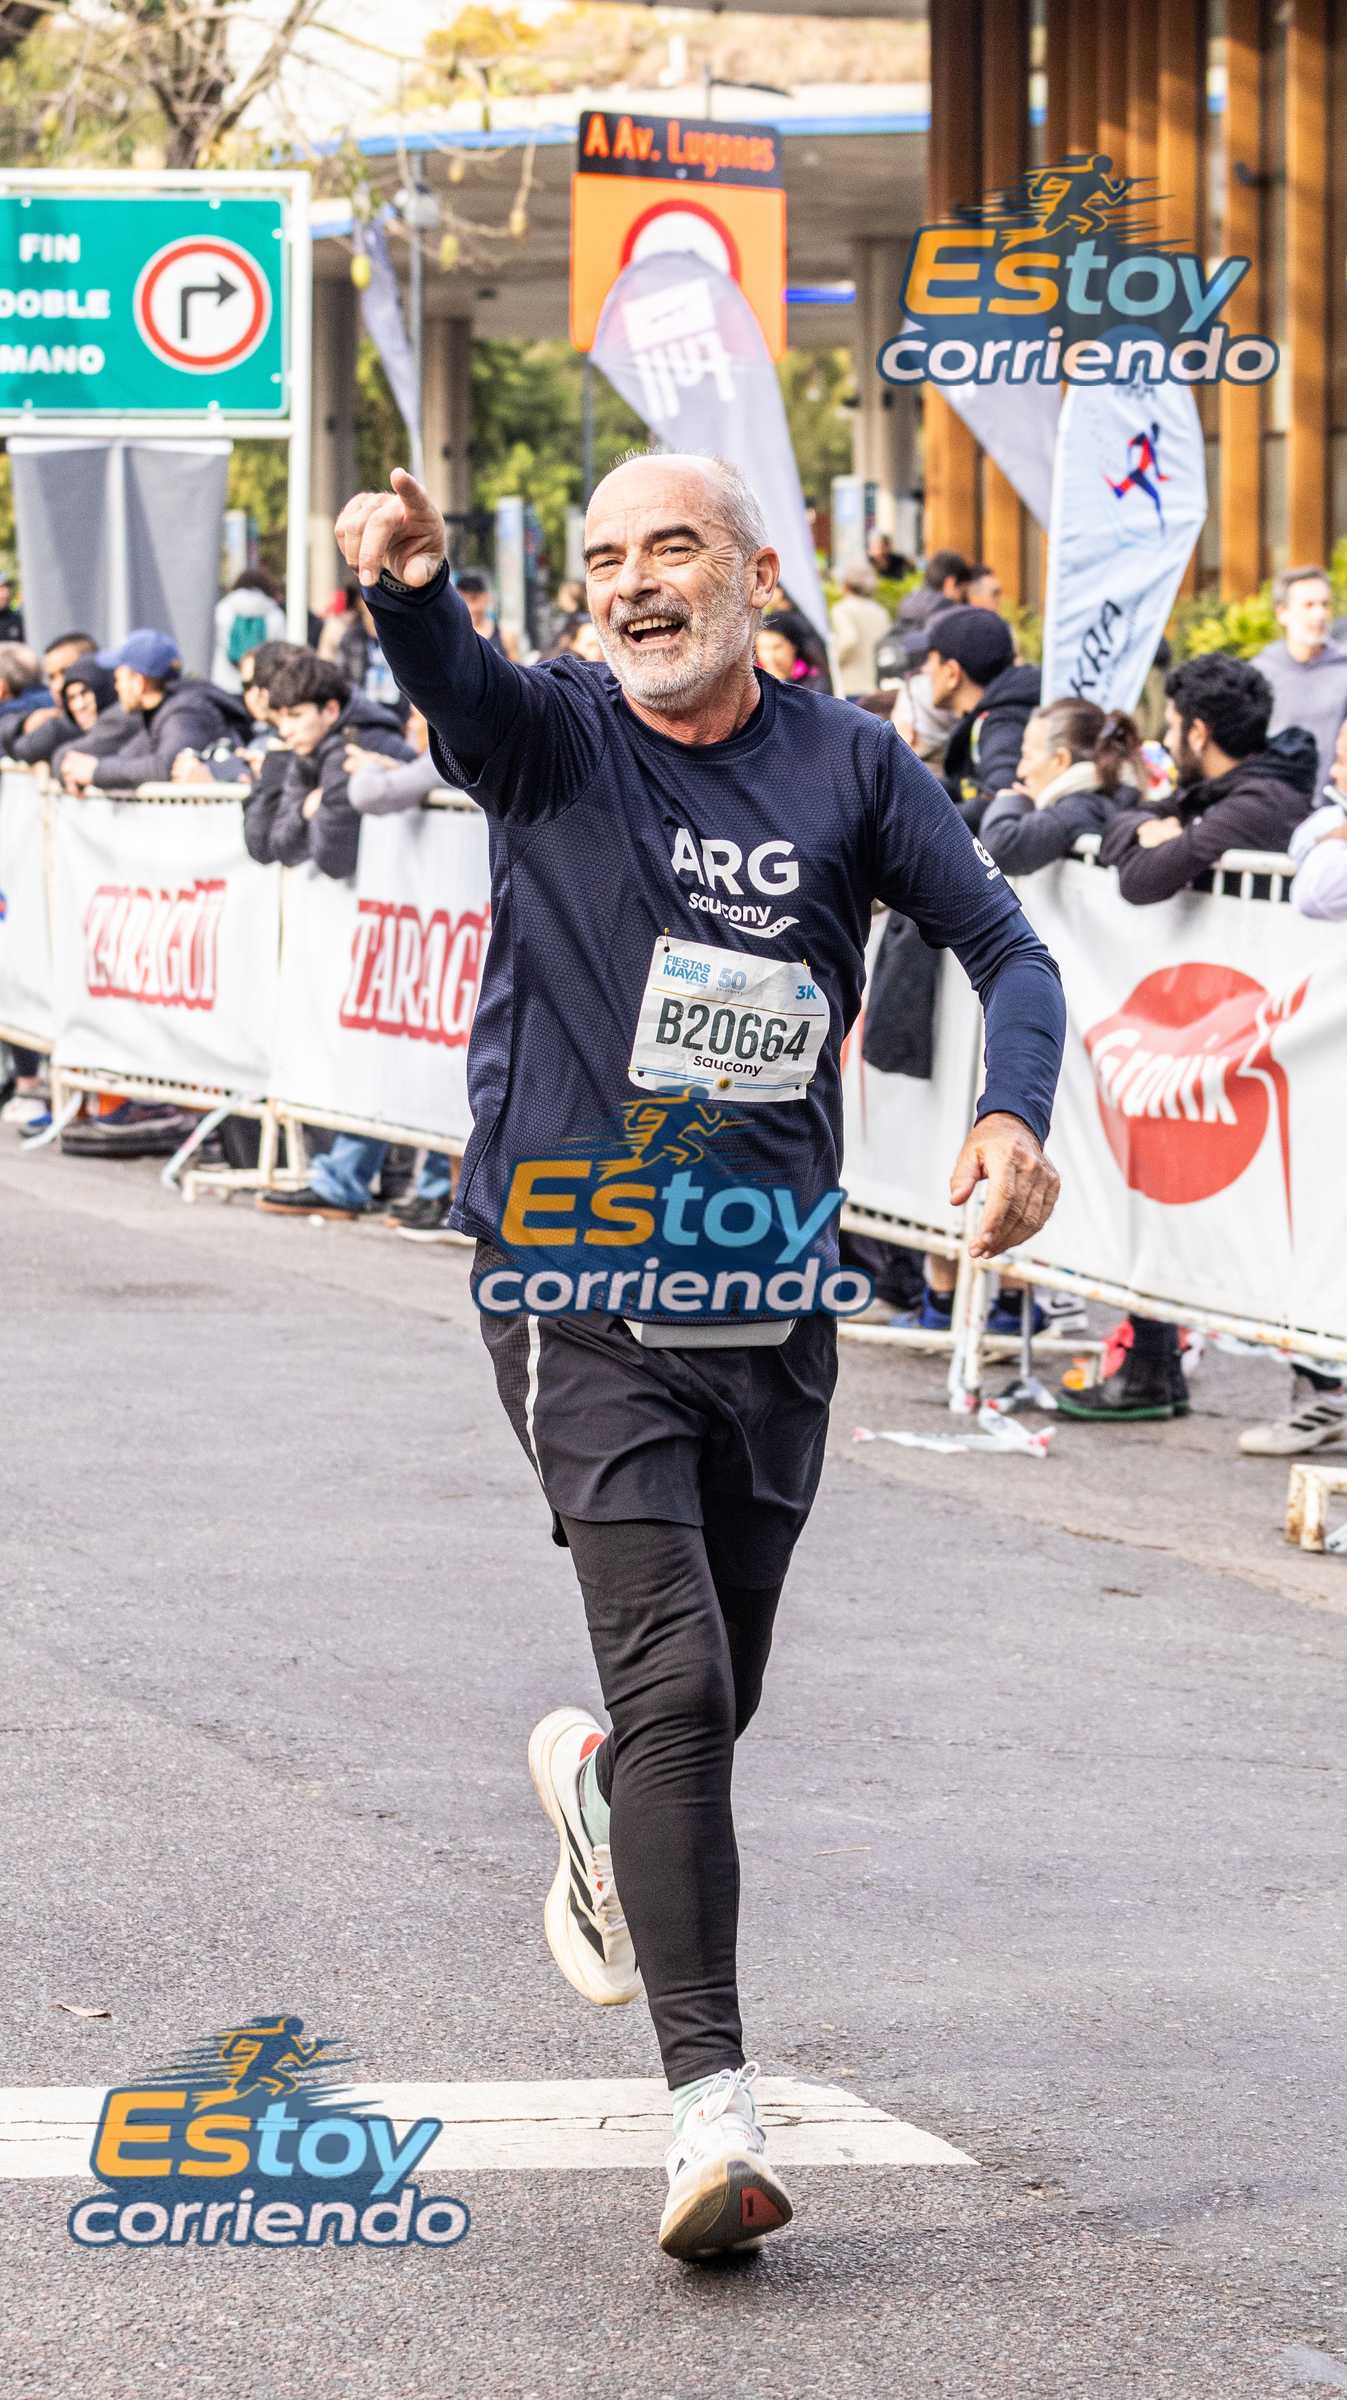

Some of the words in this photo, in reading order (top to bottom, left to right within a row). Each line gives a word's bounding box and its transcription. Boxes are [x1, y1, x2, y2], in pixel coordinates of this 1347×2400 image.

[584, 112, 610, 157] A
[613, 115, 662, 161] Av.
[667, 119, 775, 177] Lugones
[19, 232, 81, 263] FIN
[0, 289, 111, 319] DOBLE
[0, 344, 106, 375] MANO
[671, 828, 800, 896] ARG
[688, 892, 772, 926] saucony
[341, 902, 491, 1043] TARAG
[663, 964, 710, 985] MAYAS
[665, 954, 712, 974] FIESTAS
[718, 967, 748, 991] 50
[795, 984, 818, 1000] 3K
[655, 997, 811, 1063] B20664
[693, 1055, 764, 1078] saucony
